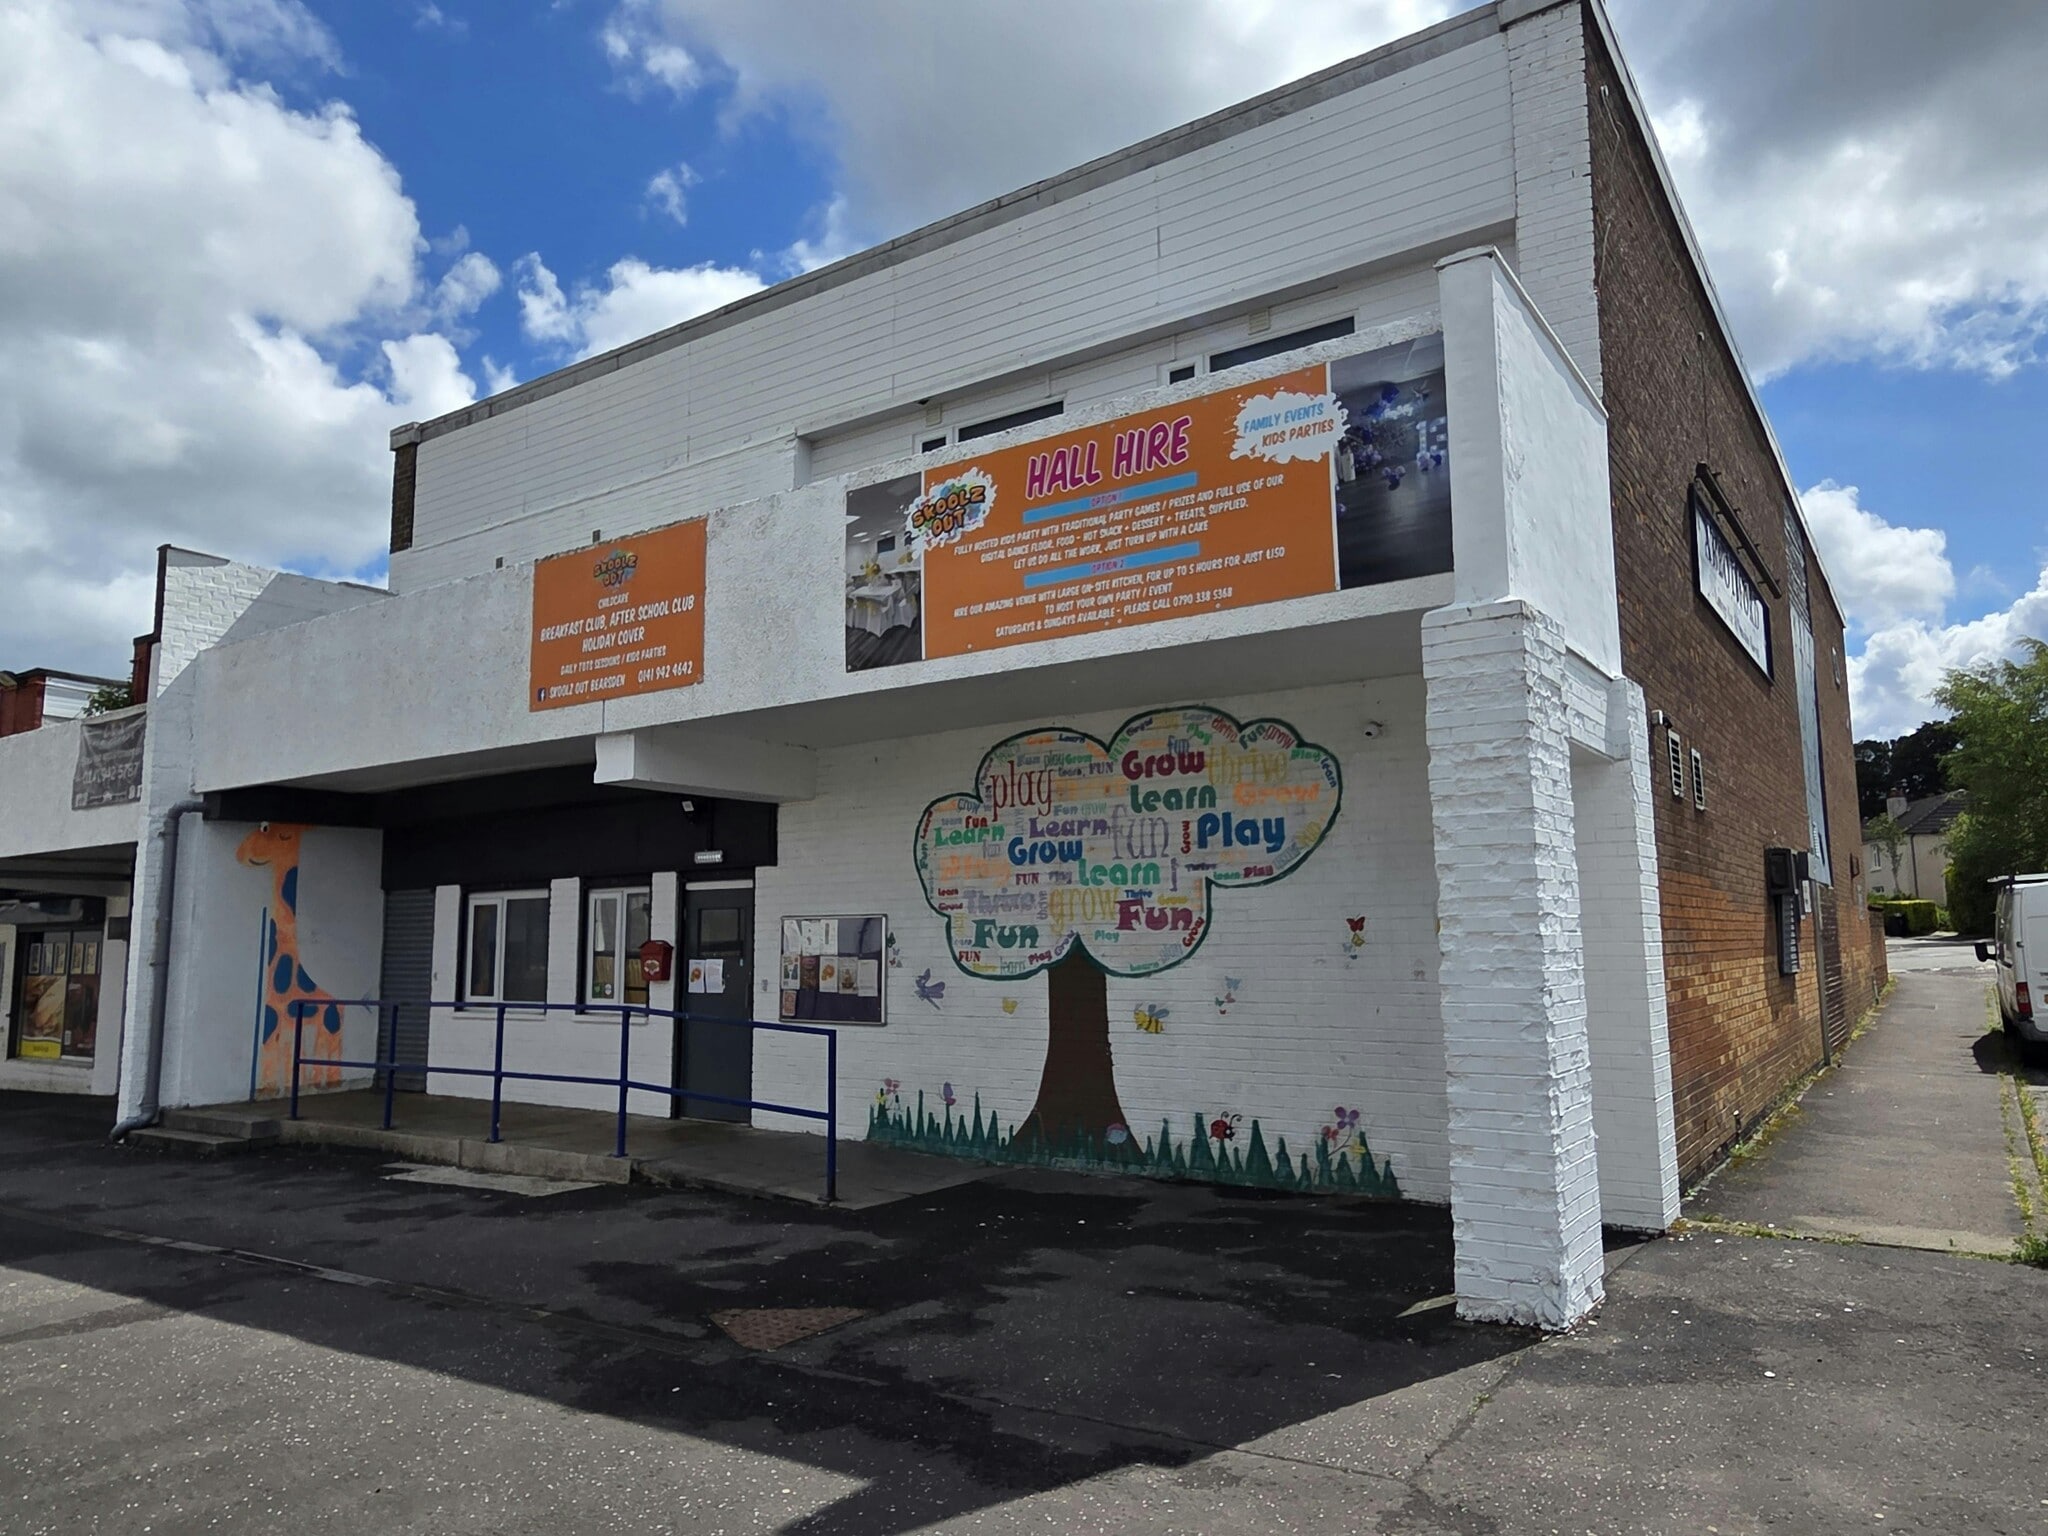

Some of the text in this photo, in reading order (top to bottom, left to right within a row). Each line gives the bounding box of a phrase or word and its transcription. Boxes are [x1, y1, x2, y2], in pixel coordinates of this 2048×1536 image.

[1243, 403, 1324, 433] FAMILY EVENTS
[1262, 419, 1334, 447] KIDS PARTIES
[1025, 415, 1192, 499] HALL HIRE
[911, 485, 986, 529] SKOOLZ
[954, 543, 972, 556] FULLY
[974, 538, 998, 551] HOSTED
[1000, 534, 1015, 545] KIDS
[1016, 529, 1040, 542] PARTY
[1042, 525, 1059, 536] WITH
[1109, 508, 1133, 522] PARTY
[1134, 502, 1160, 516] GAMES
[1169, 494, 1195, 508] PRIZES
[1196, 490, 1214, 502] AND
[1216, 486, 1234, 498] FULL
[1236, 481, 1251, 494] USE
[1254, 478, 1264, 490] OF
[1266, 474, 1284, 487] OUR
[1091, 494, 1117, 507] OPTION
[931, 508, 966, 537] OUT
[981, 550, 1005, 562] DIGITAL
[1008, 544, 1029, 557] DANCE
[1056, 535, 1075, 546] FOOD
[1083, 530, 1098, 542] HOT
[1100, 525, 1122, 538] SNACK
[1132, 516, 1164, 531] DESSERT
[1208, 498, 1248, 514] SUPPLIED.
[1014, 558, 1026, 569] LET
[1027, 557, 1037, 566] US
[1038, 554, 1048, 564] DO
[1050, 552, 1062, 562] ALL
[1064, 548, 1078, 558] THE
[1104, 539, 1122, 551] JUST
[1125, 534, 1144, 546] TURN
[1146, 532, 1156, 542] UP
[1158, 527, 1178, 540] WITH
[1180, 525, 1187, 535] A
[1188, 520, 1208, 534] CAKE
[593, 555, 638, 578] SKOOLZ
[603, 570, 624, 586] OUT
[1092, 562, 1117, 573] OPTION
[954, 606, 968, 618] HIRE
[970, 604, 983, 615] OUR
[984, 598, 1014, 612] AMAZING
[1016, 594, 1036, 606] VENUE
[1038, 590, 1056, 602] WITH
[1058, 585, 1080, 598] LARGE
[1146, 570, 1162, 582] FOR
[1164, 568, 1174, 578] UP
[1176, 565, 1187, 576] TO
[1189, 564, 1194, 574] 5
[1196, 558, 1222, 572] HOURS
[1224, 555, 1240, 568] FOR
[1242, 550, 1264, 564] JUST
[1045, 604, 1054, 615] TO
[1056, 600, 1074, 612] HOST
[1076, 597, 1095, 609] YOUR
[1096, 594, 1114, 606] OWN
[1116, 588, 1140, 602] PARTY
[1148, 582, 1173, 596] EVENT
[540, 594, 694, 642] BREAKFAST CLUB, AFTER SCHOOL CLUB
[996, 622, 1036, 637] SATURDAYS
[1044, 614, 1076, 628] SUNDAYS
[1077, 608, 1115, 622] AVAILABLE
[1124, 601, 1150, 615] PLEASE
[1152, 598, 1170, 610] CALL
[582, 626, 644, 652] HOLIDAY COVER
[560, 664, 577, 676] DAILY
[626, 650, 640, 662] KIDS
[641, 645, 666, 660] PARTIES
[638, 660, 693, 683] 0141 942 4642
[549, 674, 626, 698] SKOOLZ OUT BEARSDEN
[1122, 749, 1205, 780] Grow
[990, 760, 1054, 822] play
[934, 824, 1005, 847] Learn
[1028, 816, 1107, 838] Learn
[1106, 803, 1169, 859] fun
[1197, 811, 1285, 854] Play
[1008, 836, 1083, 866] Grow
[1016, 872, 1040, 886] FUN
[1115, 896, 1193, 931] Fun
[971, 918, 1039, 949] Fun
[958, 950, 981, 962] FUN
